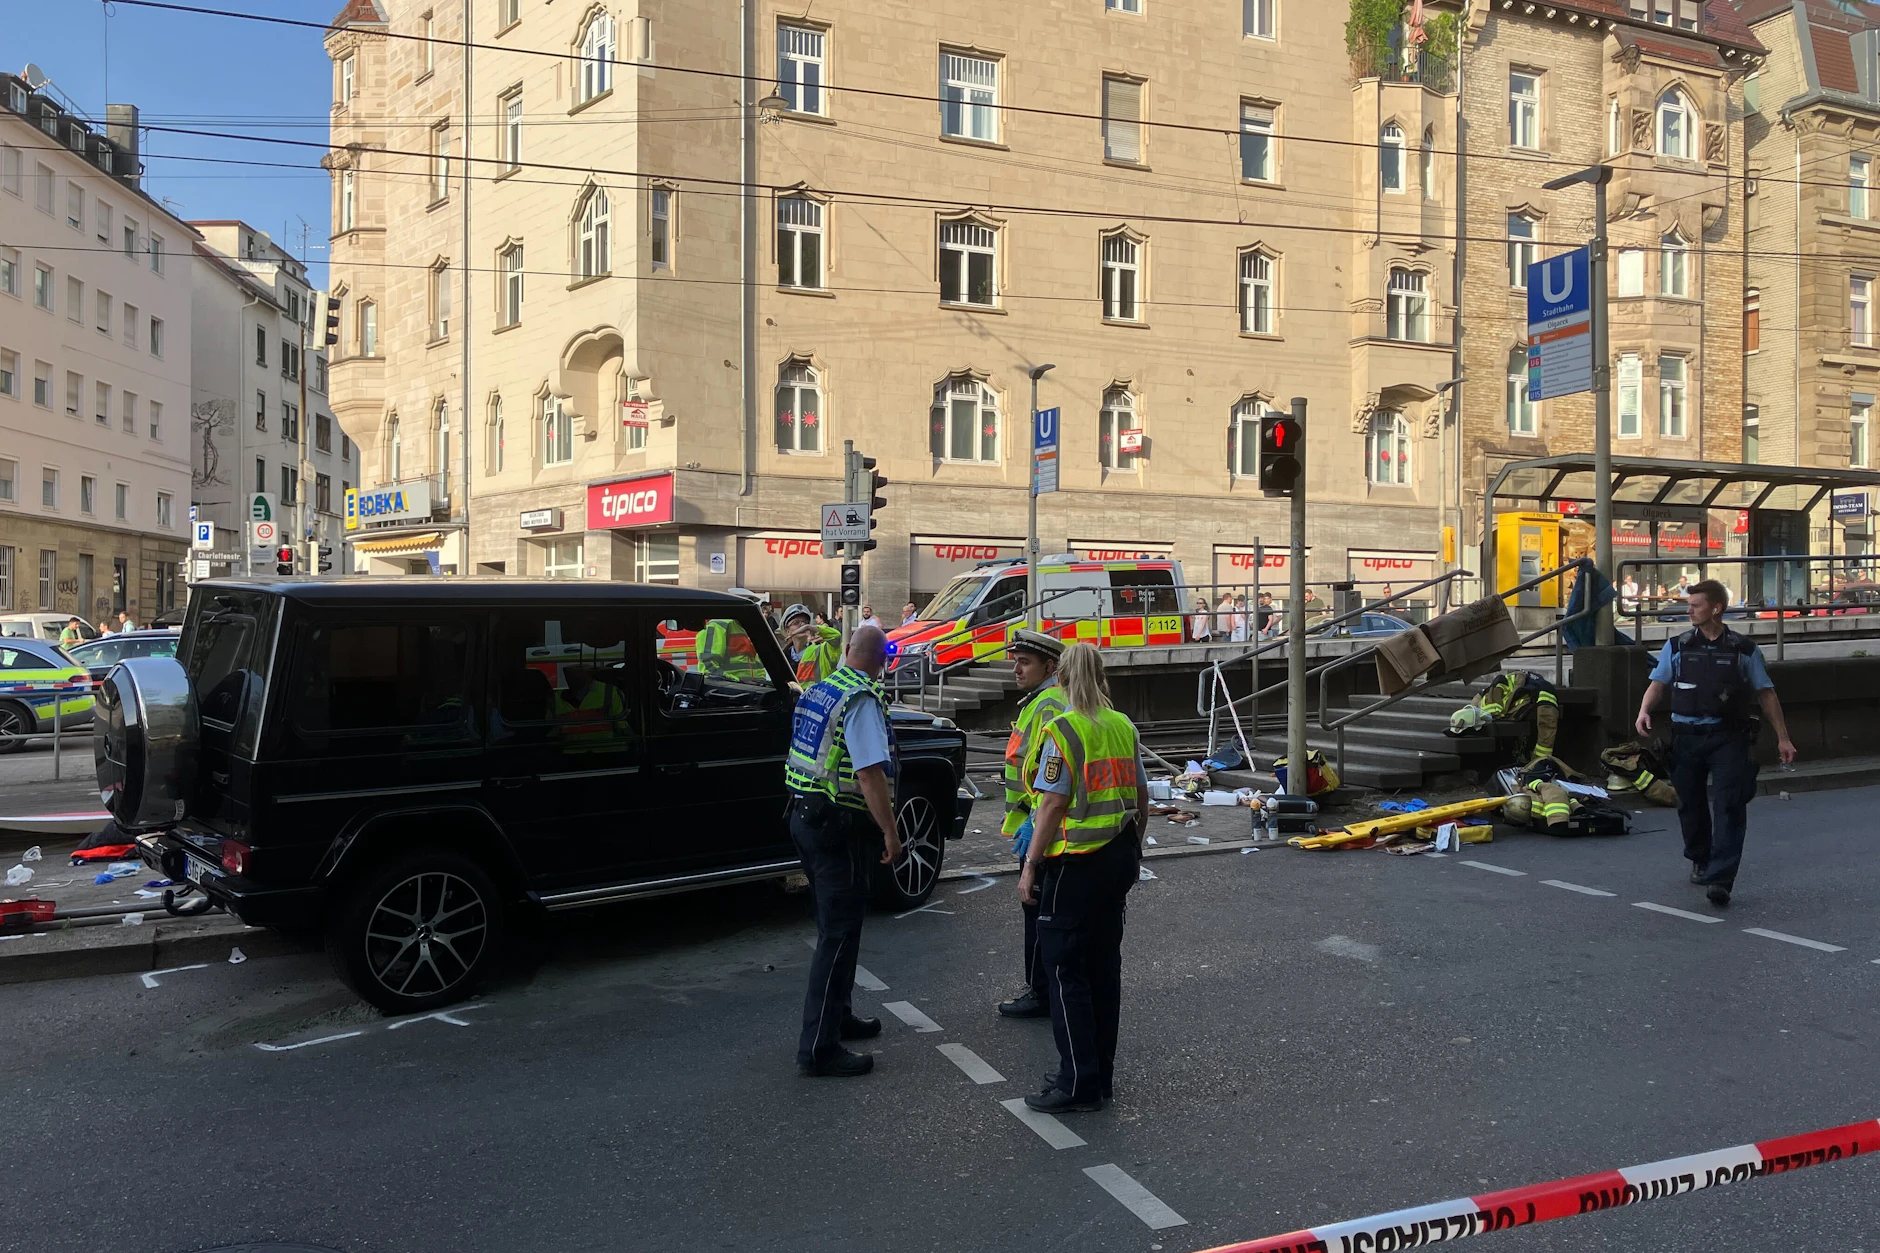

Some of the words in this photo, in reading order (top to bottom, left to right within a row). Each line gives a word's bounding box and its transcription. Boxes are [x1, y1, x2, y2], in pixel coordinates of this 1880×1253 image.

[1542, 255, 1573, 304] U
[1543, 303, 1574, 318] Stadtbahn
[1547, 318, 1569, 330] Olgaeck
[1040, 411, 1052, 438] U
[359, 491, 405, 516] EDEKA
[601, 488, 657, 522] tipico
[1642, 507, 1673, 520] Olgaeck
[260, 527, 270, 535] 30
[840, 529, 866, 537] Vorrang
[198, 552, 242, 561] Charlottenstr.
[933, 544, 998, 562] tipico
[1230, 554, 1285, 570] tipco
[1363, 558, 1413, 571] tipico
[1158, 619, 1177, 630] 112
